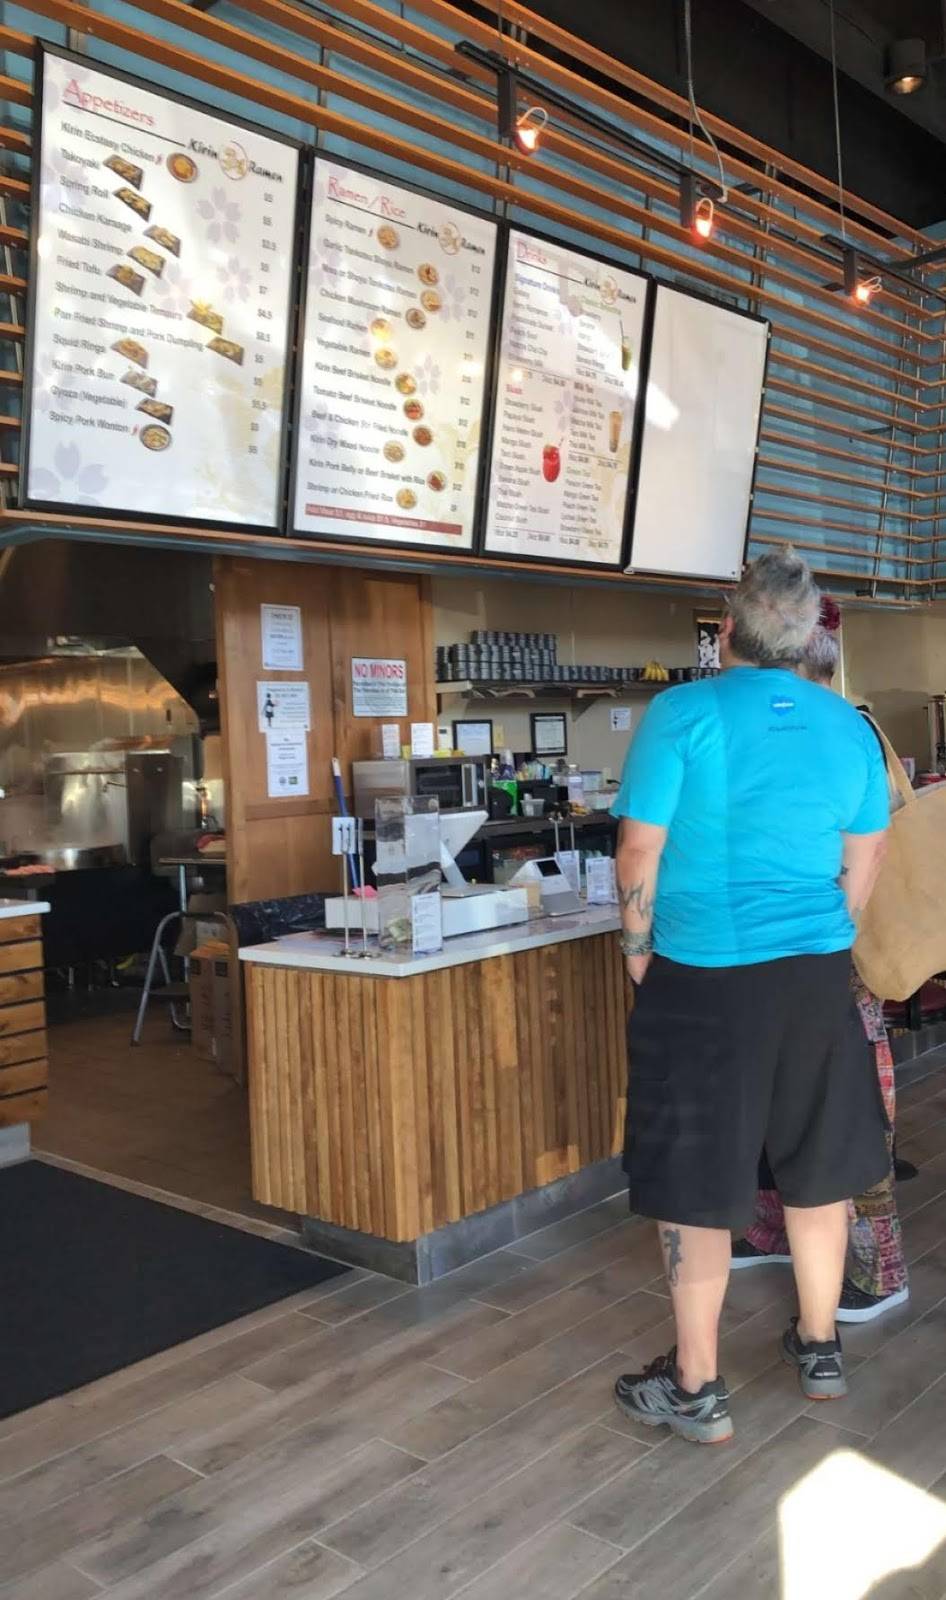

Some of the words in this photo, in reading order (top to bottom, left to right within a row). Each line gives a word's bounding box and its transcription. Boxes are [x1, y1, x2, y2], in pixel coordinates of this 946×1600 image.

[63, 78, 155, 127] Appetizers
[354, 664, 368, 678] NO
[371, 664, 404, 679] MINORS
